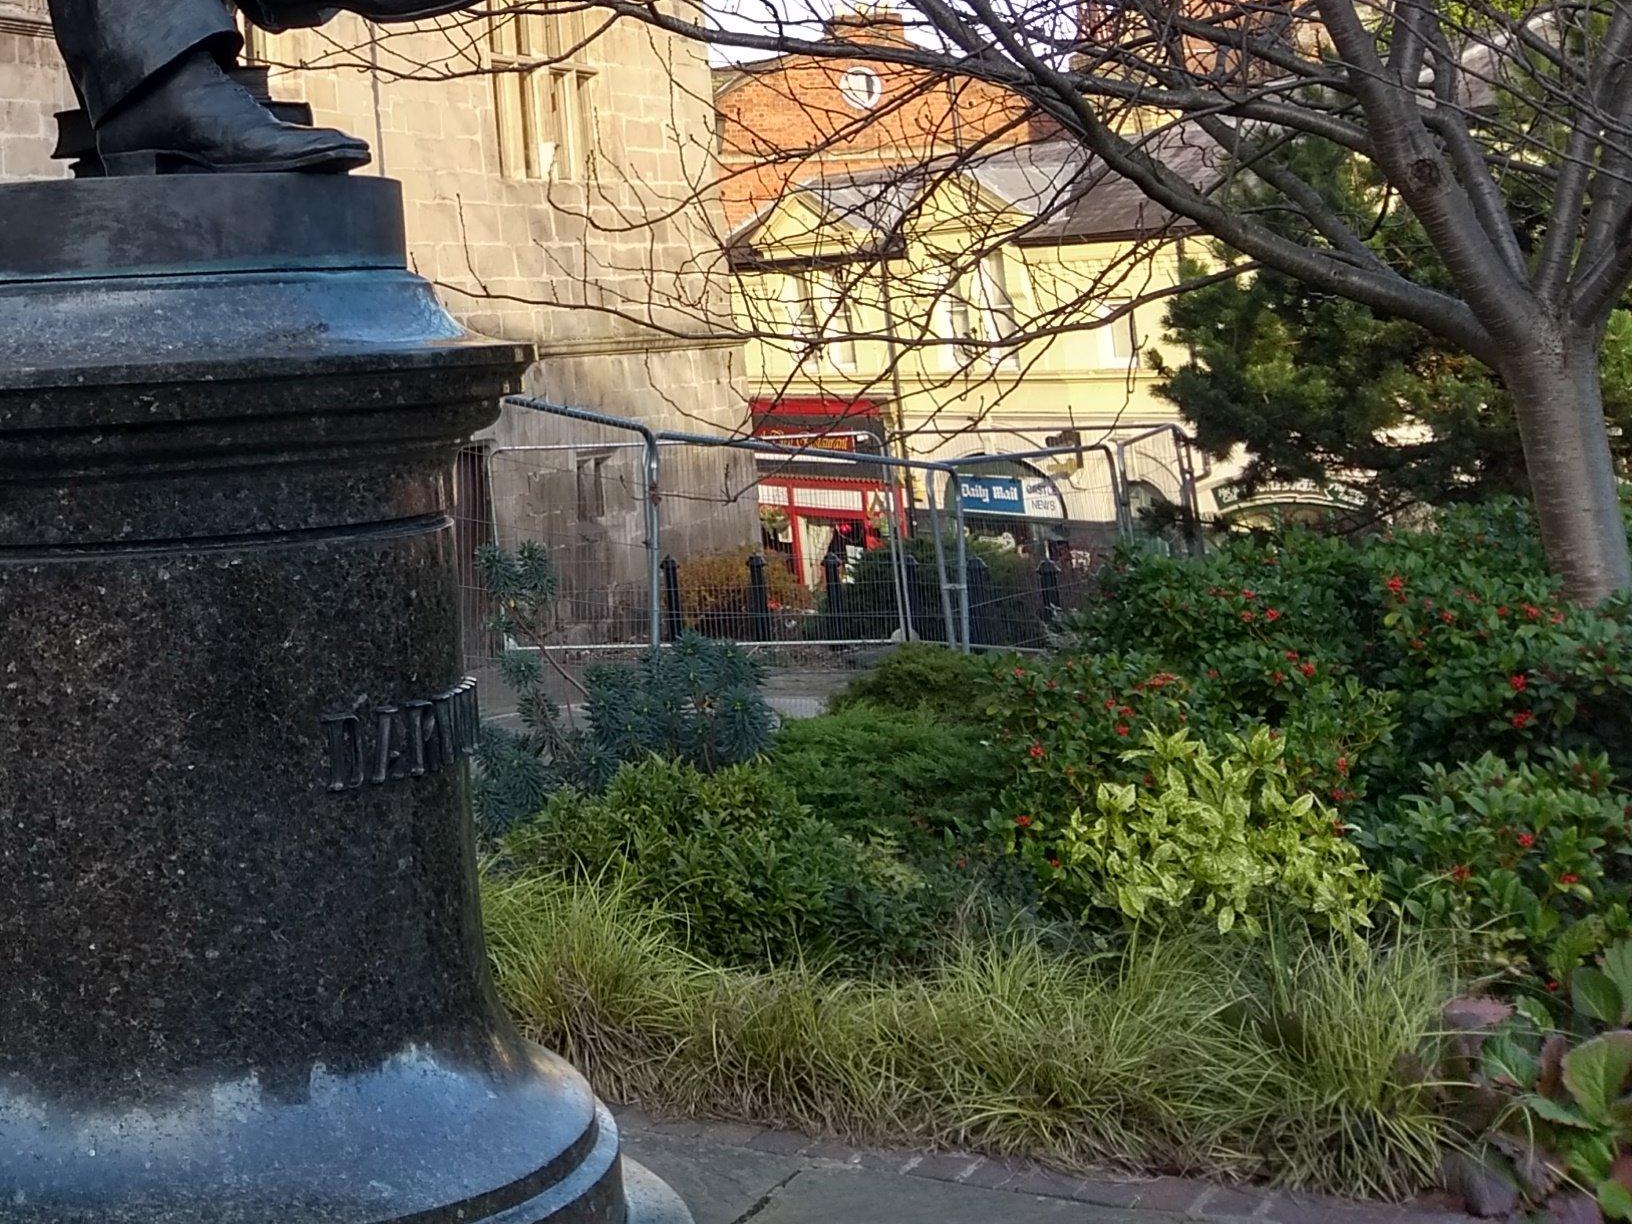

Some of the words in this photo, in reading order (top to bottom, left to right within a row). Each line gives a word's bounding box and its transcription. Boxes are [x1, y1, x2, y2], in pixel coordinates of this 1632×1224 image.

[960, 483, 989, 503] Daily
[992, 485, 1019, 501] Mail
[1031, 499, 1056, 511] NEWS
